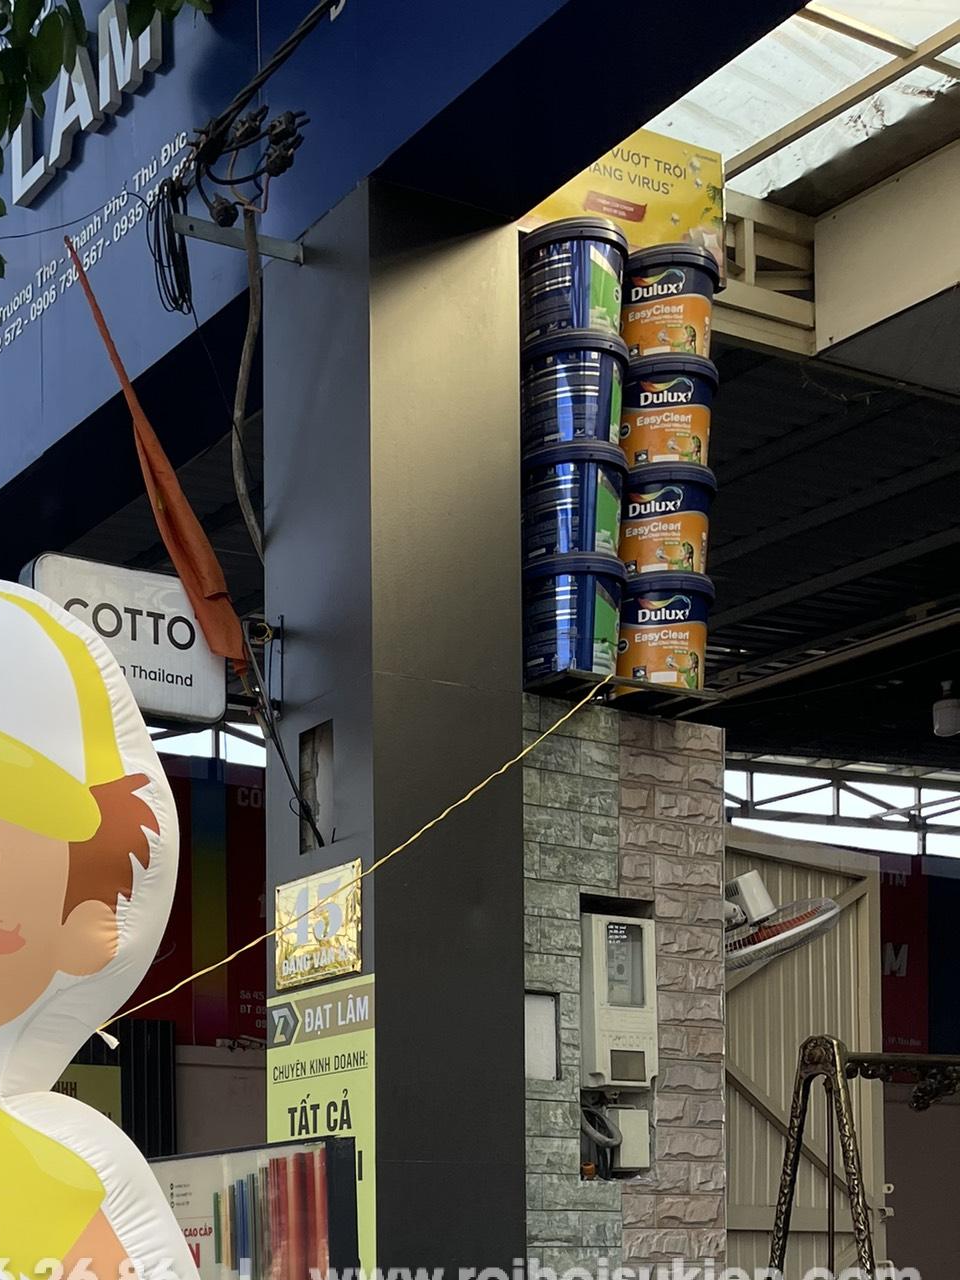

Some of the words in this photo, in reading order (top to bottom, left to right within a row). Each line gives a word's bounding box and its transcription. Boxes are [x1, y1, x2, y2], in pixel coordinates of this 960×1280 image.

[631, 282, 681, 302] Dulux
[639, 389, 692, 407] Dulux
[628, 498, 680, 517] Dulux
[637, 607, 689, 624] Dulux
[130, 664, 194, 687] Thailand
[304, 1004, 333, 1036] ĐẠT
[338, 993, 369, 1026] LÂM
[310, 1055, 331, 1076] KINH
[287, 1094, 321, 1137] TẤT
[326, 1088, 353, 1133] CẢ
